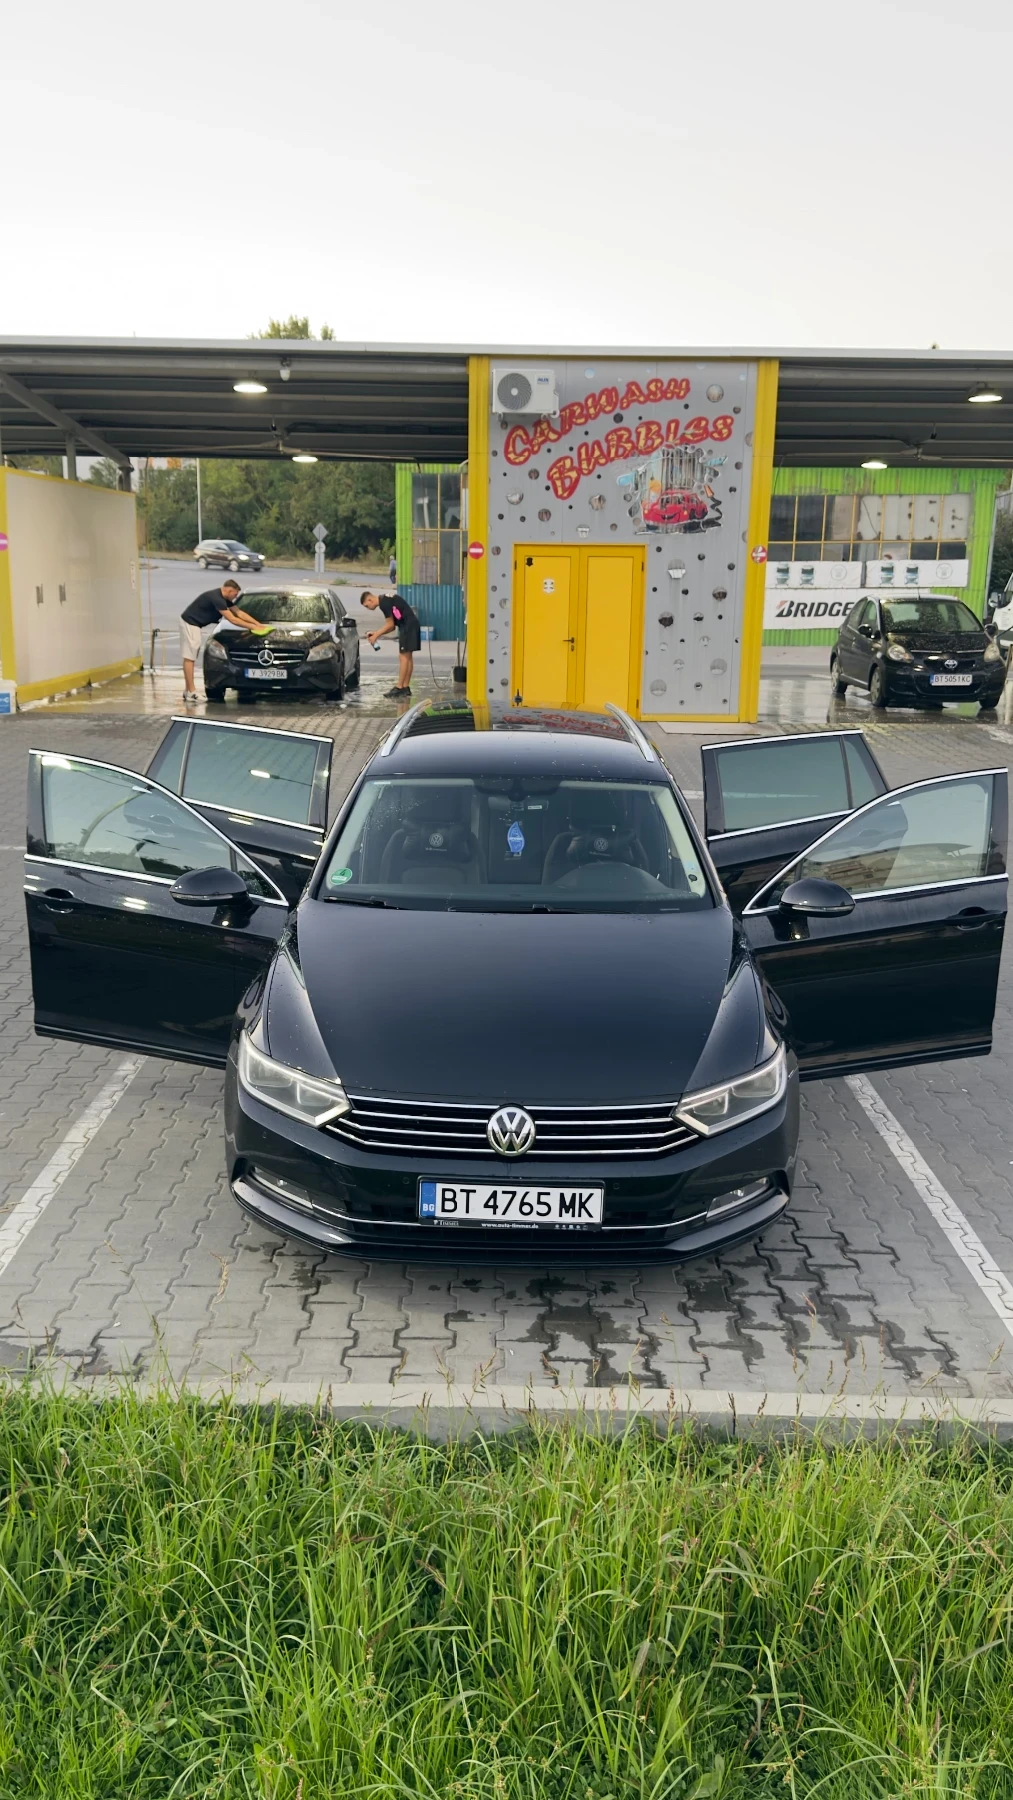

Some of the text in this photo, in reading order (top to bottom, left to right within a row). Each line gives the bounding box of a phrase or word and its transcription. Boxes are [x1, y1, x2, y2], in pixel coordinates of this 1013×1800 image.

[504, 378, 690, 465] CARWASH
[547, 415, 734, 499] BUBBLES
[934, 675, 971, 683] BT 5051 KC
[422, 1188, 594, 1218] BG BT 4765 MK
